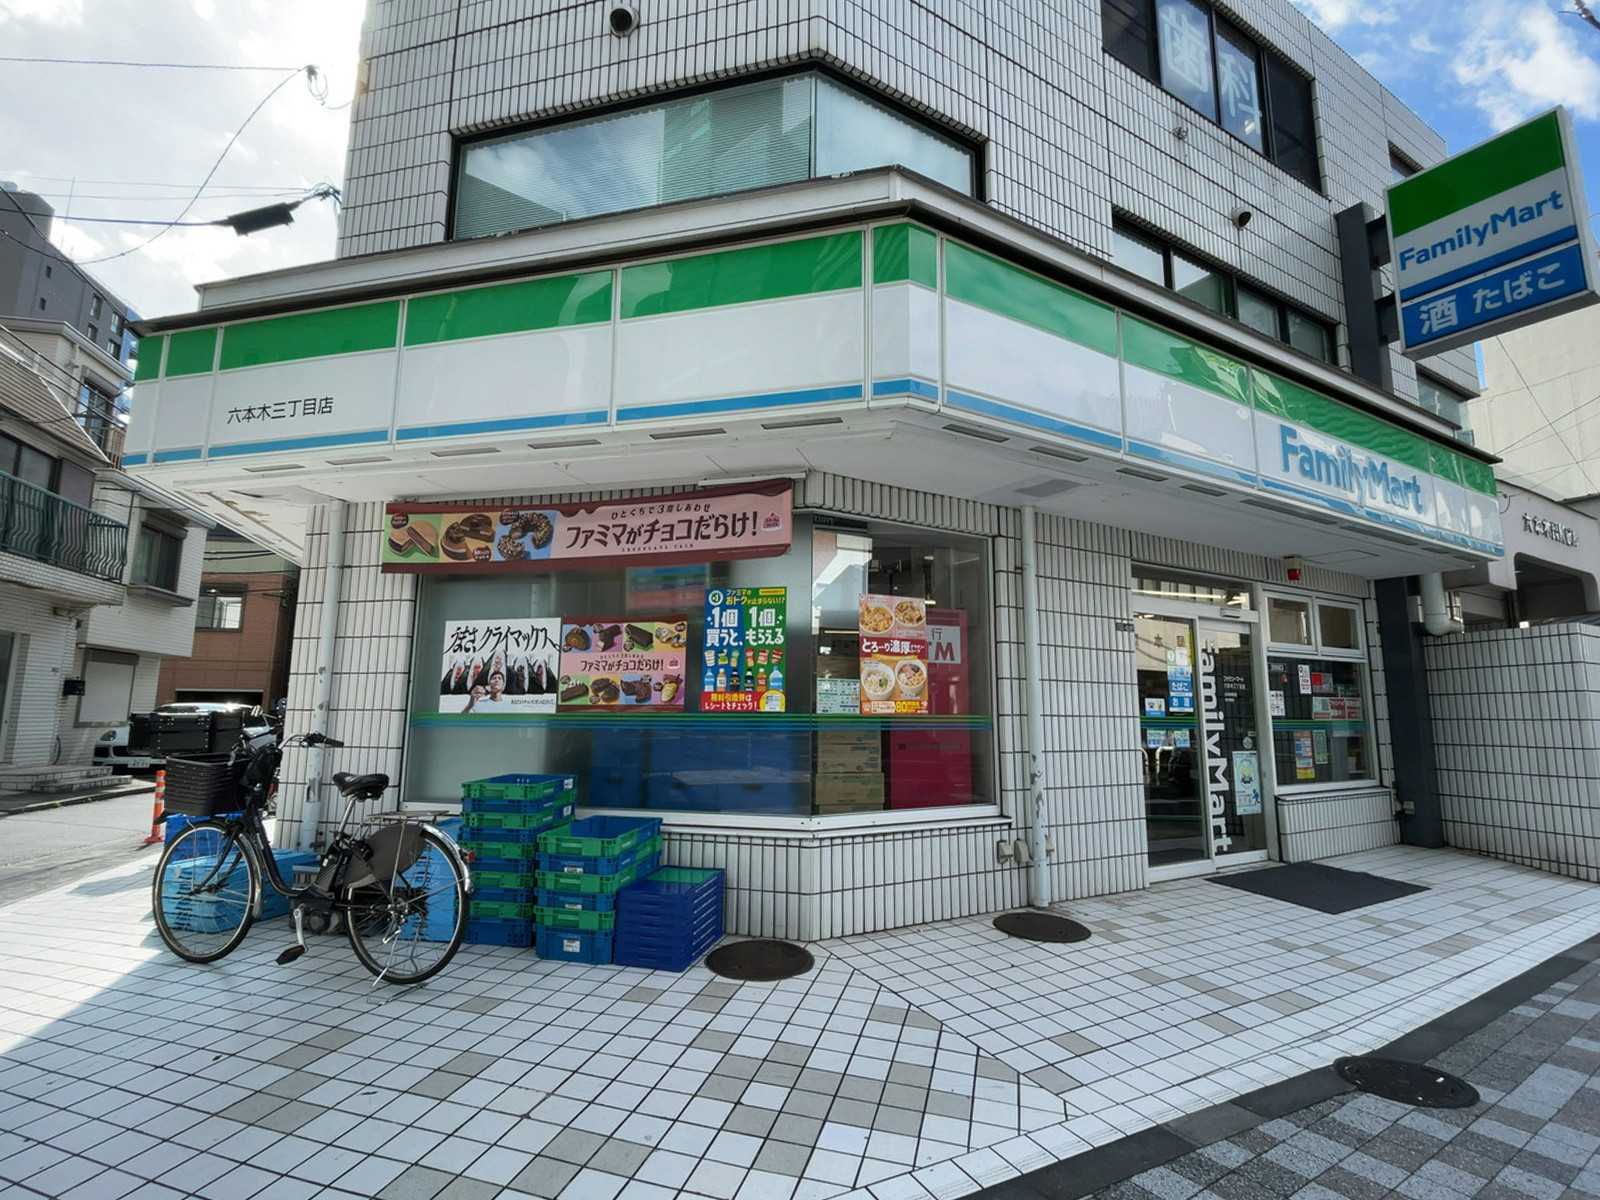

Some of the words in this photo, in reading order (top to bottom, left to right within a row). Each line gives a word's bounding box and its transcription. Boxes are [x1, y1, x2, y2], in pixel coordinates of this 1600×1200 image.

[1399, 190, 1564, 271] FamilyMart
[1418, 293, 1458, 335] 酒
[1472, 262, 1565, 314] たばこ
[227, 396, 334, 424] 六本木三丁目店
[1279, 422, 1424, 515] FamilyMart
[566, 510, 758, 549] ファミマがチョコだらけ！
[712, 606, 738, 628] 1個
[749, 606, 776, 627] 1個
[745, 628, 784, 646] もらえる
[931, 627, 943, 640] 行
